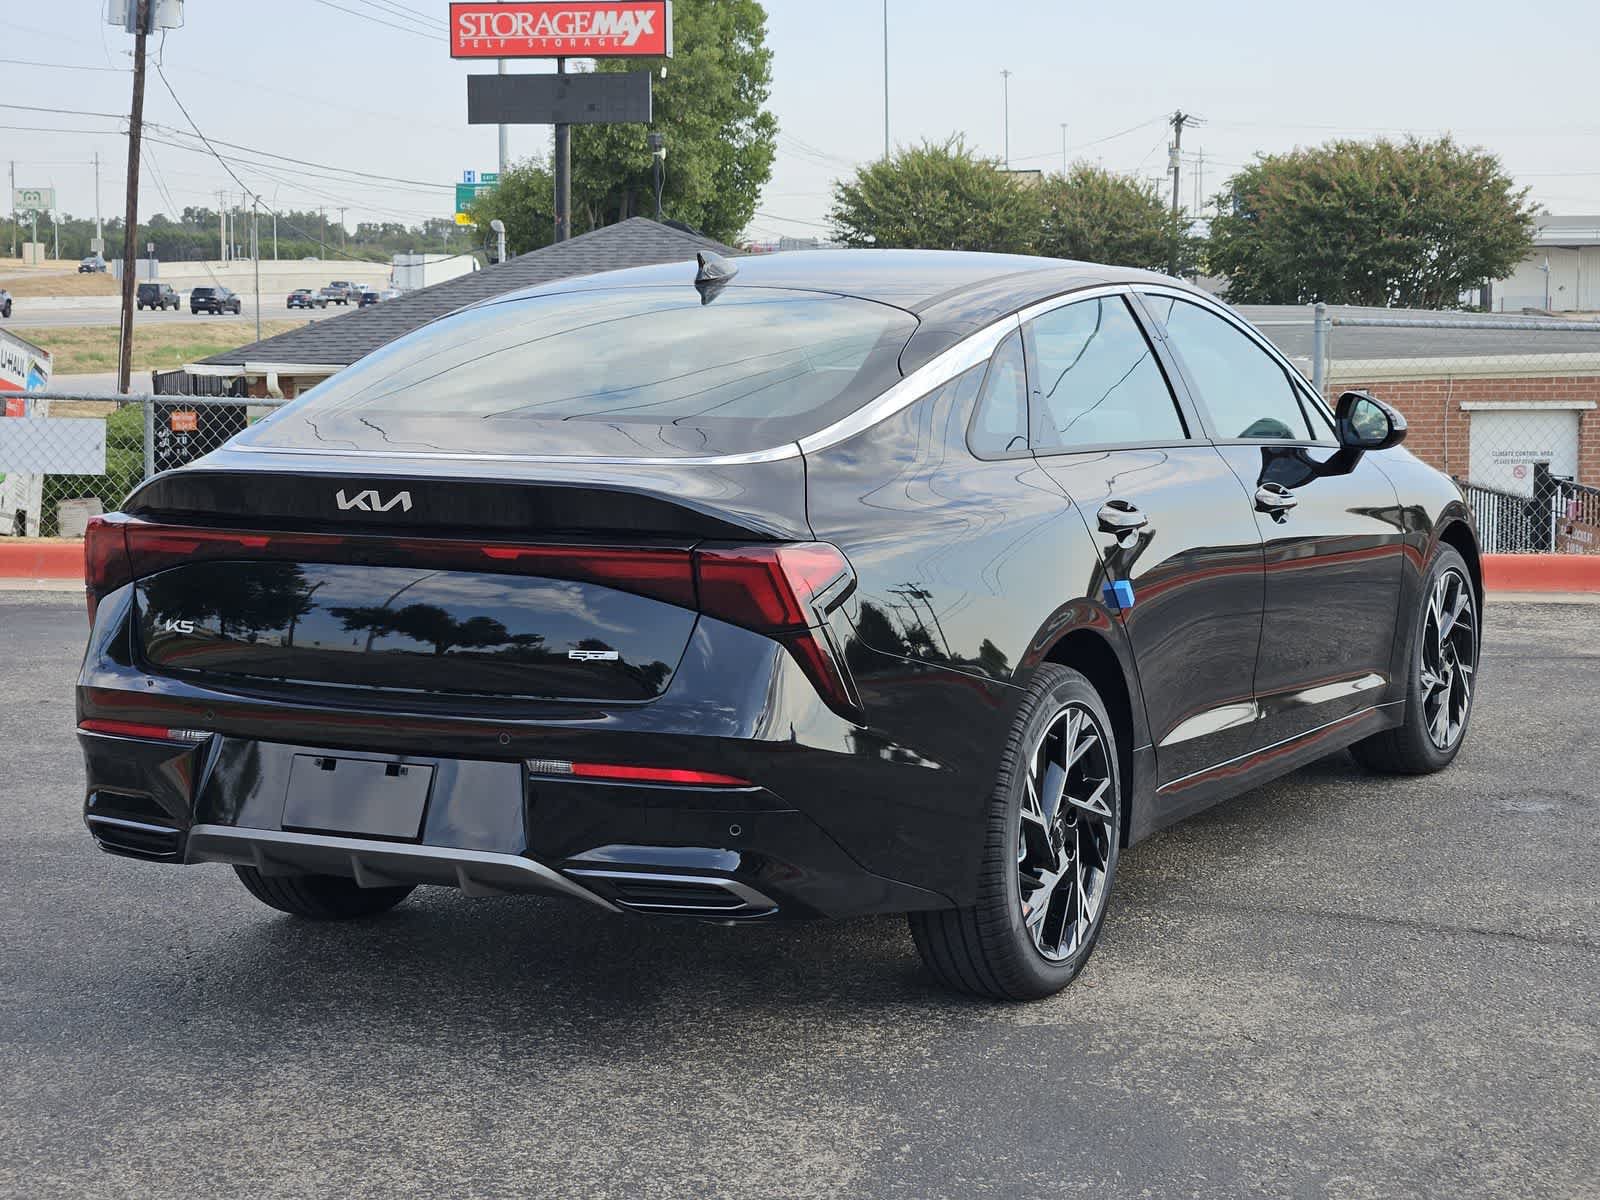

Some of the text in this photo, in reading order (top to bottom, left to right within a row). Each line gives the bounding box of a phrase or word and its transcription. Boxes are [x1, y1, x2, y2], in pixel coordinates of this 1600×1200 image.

[460, 38, 617, 48] SELF STORAGE
[335, 488, 413, 513] KIA
